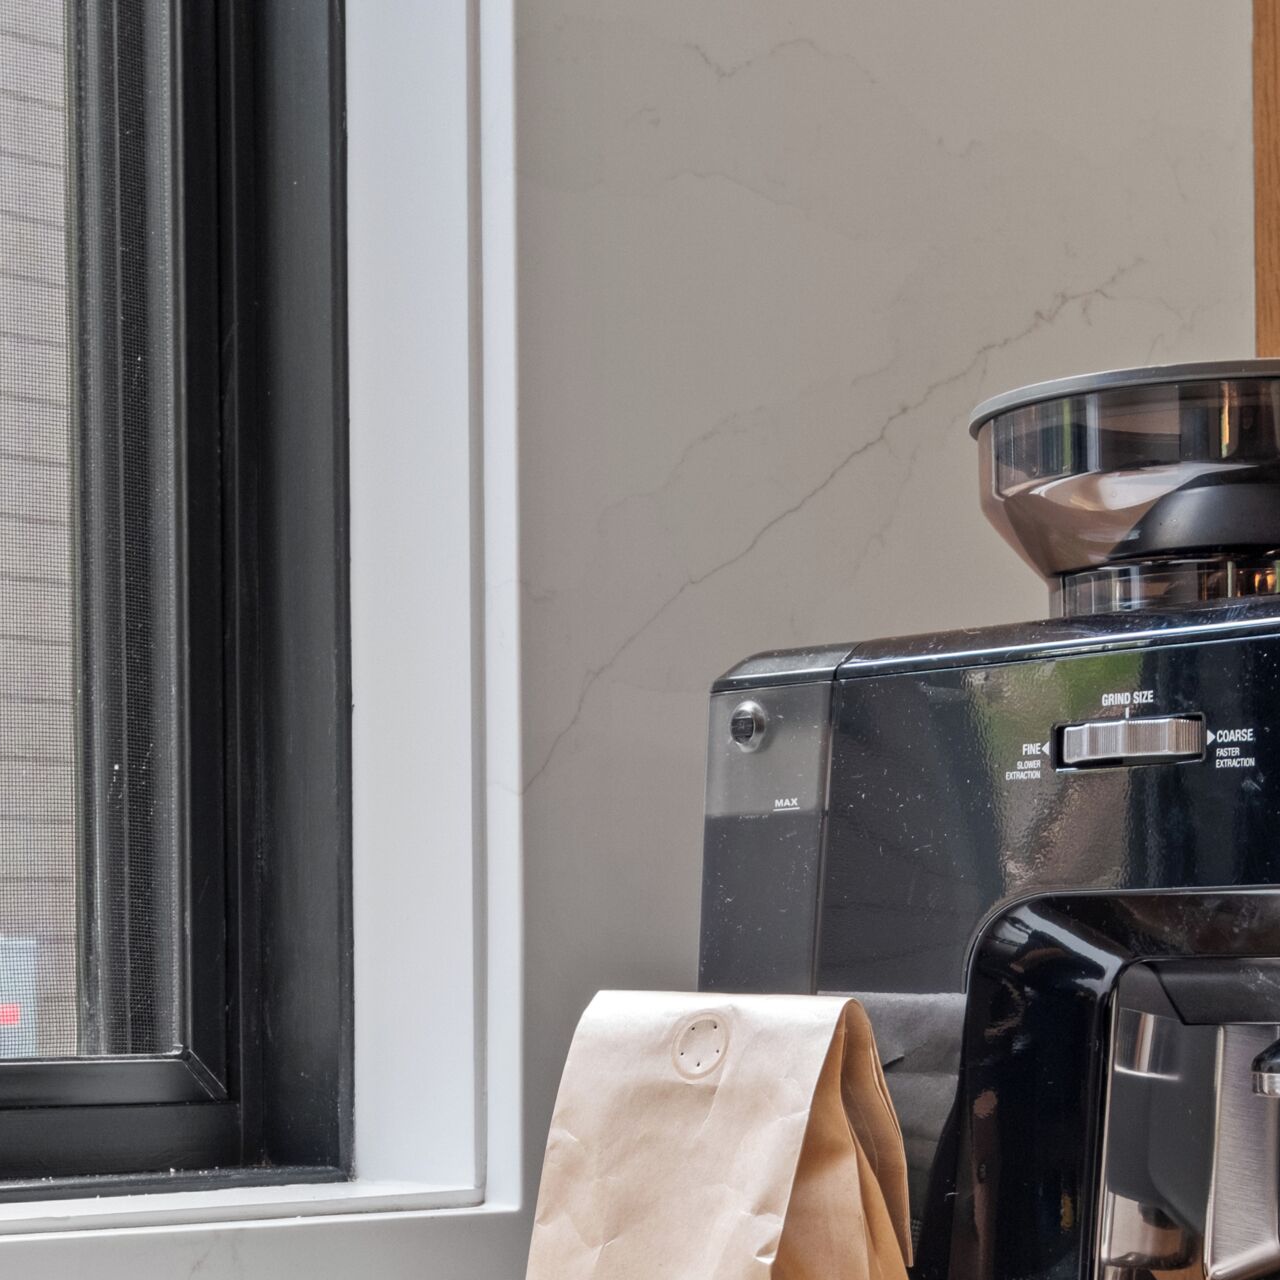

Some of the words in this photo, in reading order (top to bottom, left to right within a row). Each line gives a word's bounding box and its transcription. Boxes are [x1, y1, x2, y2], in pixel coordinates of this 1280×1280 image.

[1102, 693, 1130, 707] GRIND
[1132, 690, 1154, 704] SIZE
[1216, 728, 1254, 743] COARSE
[1022, 743, 1041, 756] FINE
[1216, 747, 1240, 757] FASTER
[1016, 760, 1041, 770] SLOWER
[1216, 757, 1255, 769] EXTRACTION
[1005, 770, 1041, 781] EXTRACTION
[774, 798, 798, 808] MAX
